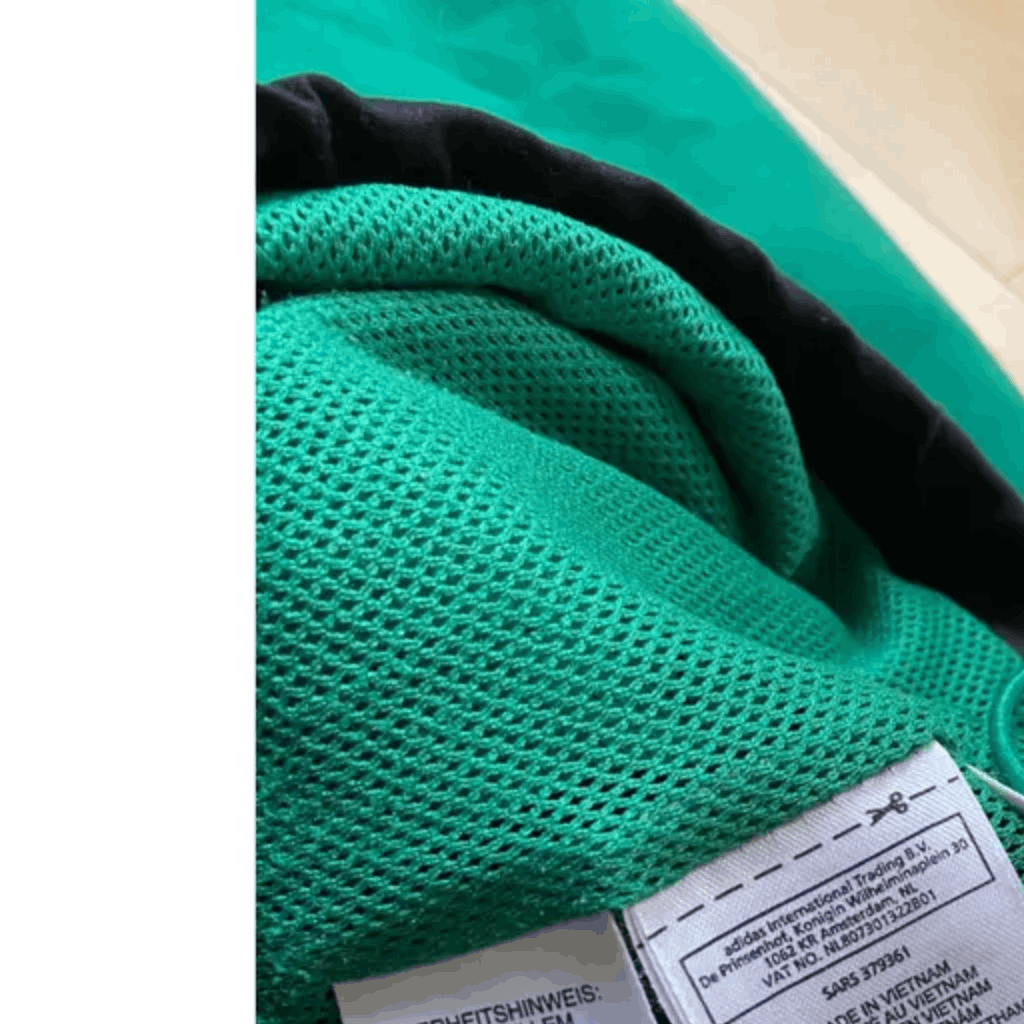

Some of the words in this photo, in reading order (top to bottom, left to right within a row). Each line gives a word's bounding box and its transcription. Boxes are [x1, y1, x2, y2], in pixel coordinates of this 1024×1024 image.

[698, 972, 720, 990] De
[844, 848, 950, 909] Wilhelminaplein
[950, 837, 970, 855] 30
[723, 927, 767, 957] adidas
[765, 879, 854, 933] International
[853, 855, 905, 888] Trading
[903, 839, 932, 861] B.V.
[763, 944, 798, 969] 1062
[796, 933, 820, 952] KR
[820, 895, 899, 942] Amsterdam,
[897, 882, 919, 899] NL
[761, 964, 793, 988] VAT
[792, 951, 823, 973] NO.
[821, 971, 861, 1001] SARS
[859, 944, 911, 981] 379361
[859, 997, 881, 1017] IN
[878, 959, 952, 1006] VIETNAM
[907, 964, 980, 1011] VIETNAM
[919, 977, 993, 1024] VIETNAM
